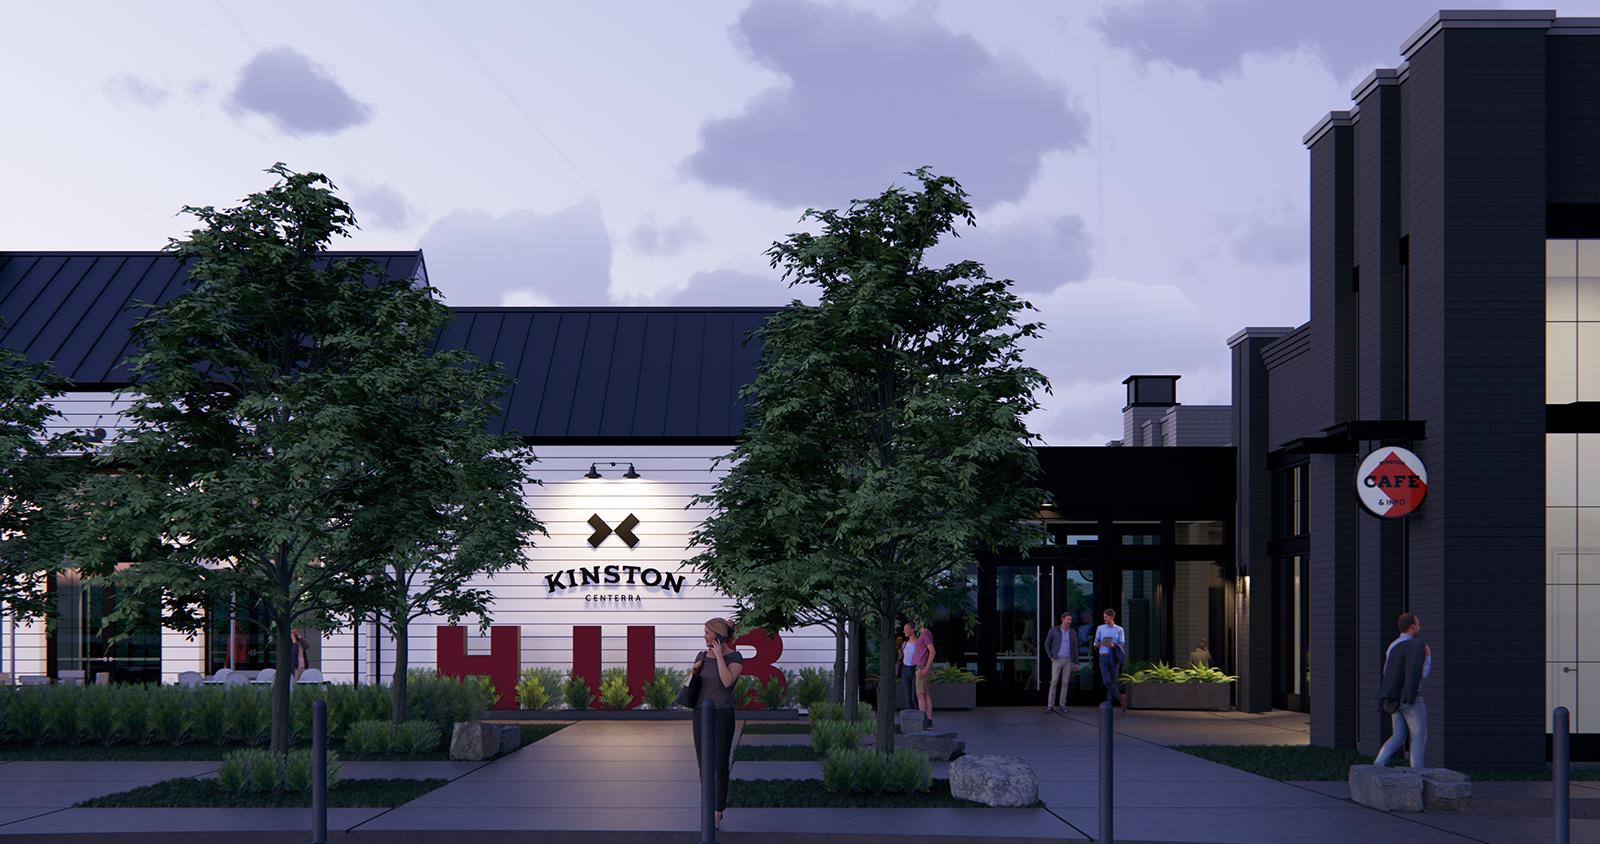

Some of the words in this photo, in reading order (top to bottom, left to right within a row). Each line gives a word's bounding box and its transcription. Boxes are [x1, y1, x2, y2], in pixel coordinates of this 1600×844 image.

[1363, 475, 1420, 488] CAFE
[544, 565, 686, 593] KINSTON
[585, 594, 642, 602] CENTERRA
[436, 625, 787, 710] HUB
